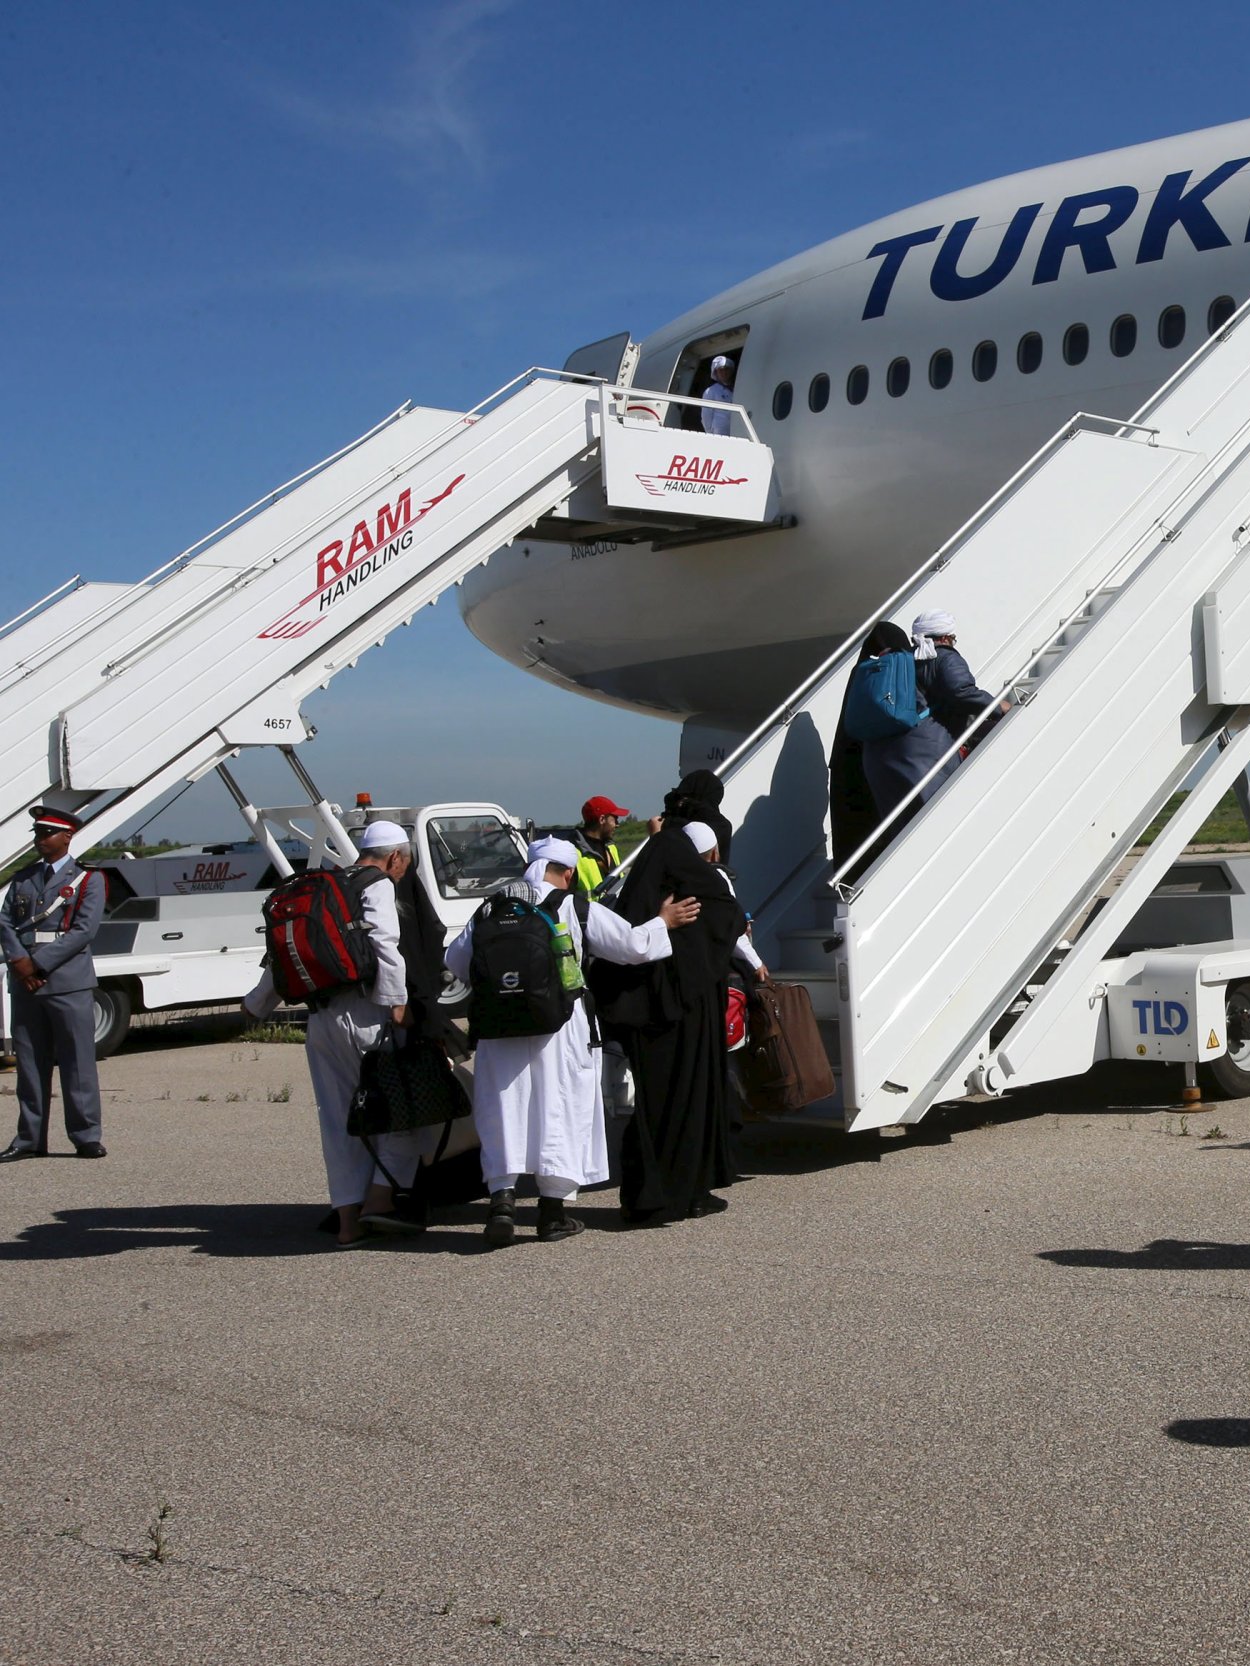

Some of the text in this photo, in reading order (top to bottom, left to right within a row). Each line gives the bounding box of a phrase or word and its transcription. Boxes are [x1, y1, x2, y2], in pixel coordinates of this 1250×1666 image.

[668, 455, 724, 480] RAM
[664, 480, 716, 495] HANDLING
[317, 487, 411, 588] RAM
[319, 530, 413, 611] HANDLING
[264, 718, 292, 729] 4657
[193, 862, 230, 880] RAM
[190, 881, 225, 891] HANDLING
[1132, 1000, 1189, 1036] TLD
